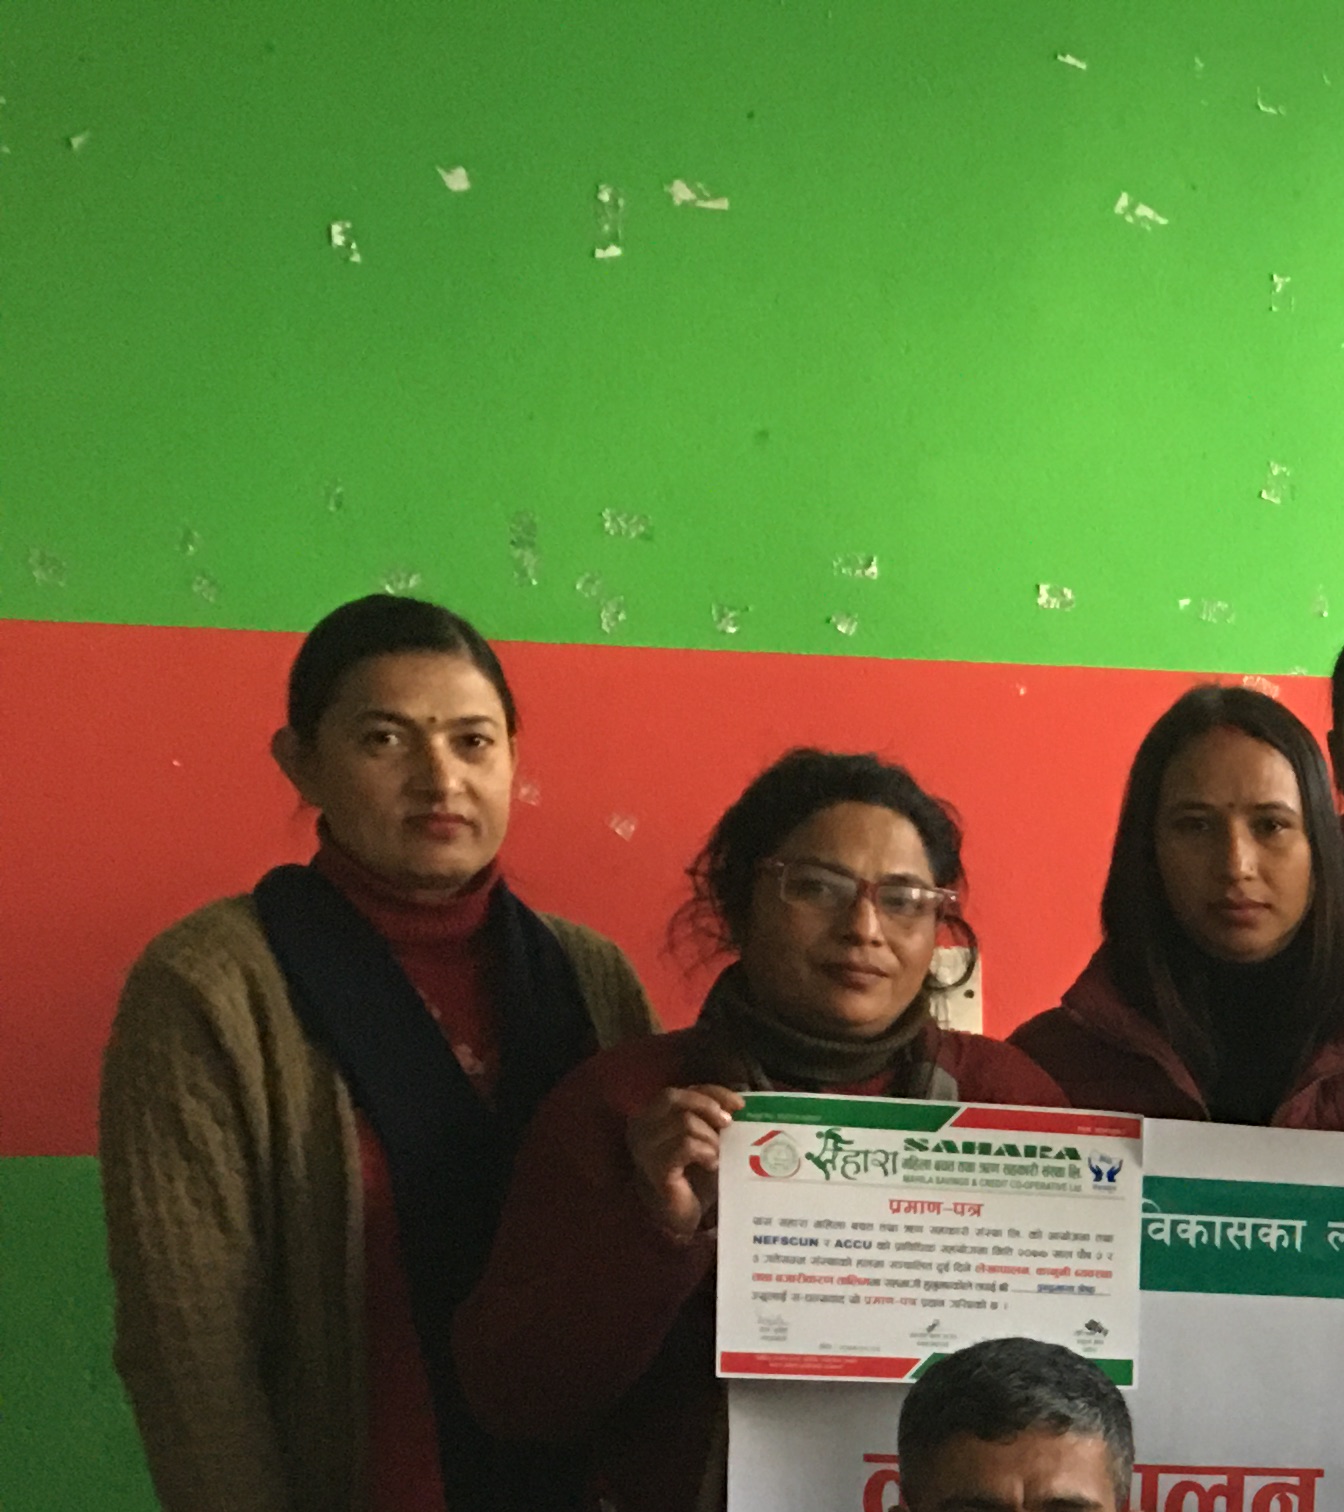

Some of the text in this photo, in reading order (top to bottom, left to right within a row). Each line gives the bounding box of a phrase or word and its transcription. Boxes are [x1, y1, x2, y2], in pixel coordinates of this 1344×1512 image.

[903, 1137, 1082, 1160] SAHARA
[888, 1198, 984, 1217] प्रमाण-पत्र
[752, 1235, 819, 1247] NEFSCUN
[834, 1239, 872, 1250] ACCU
